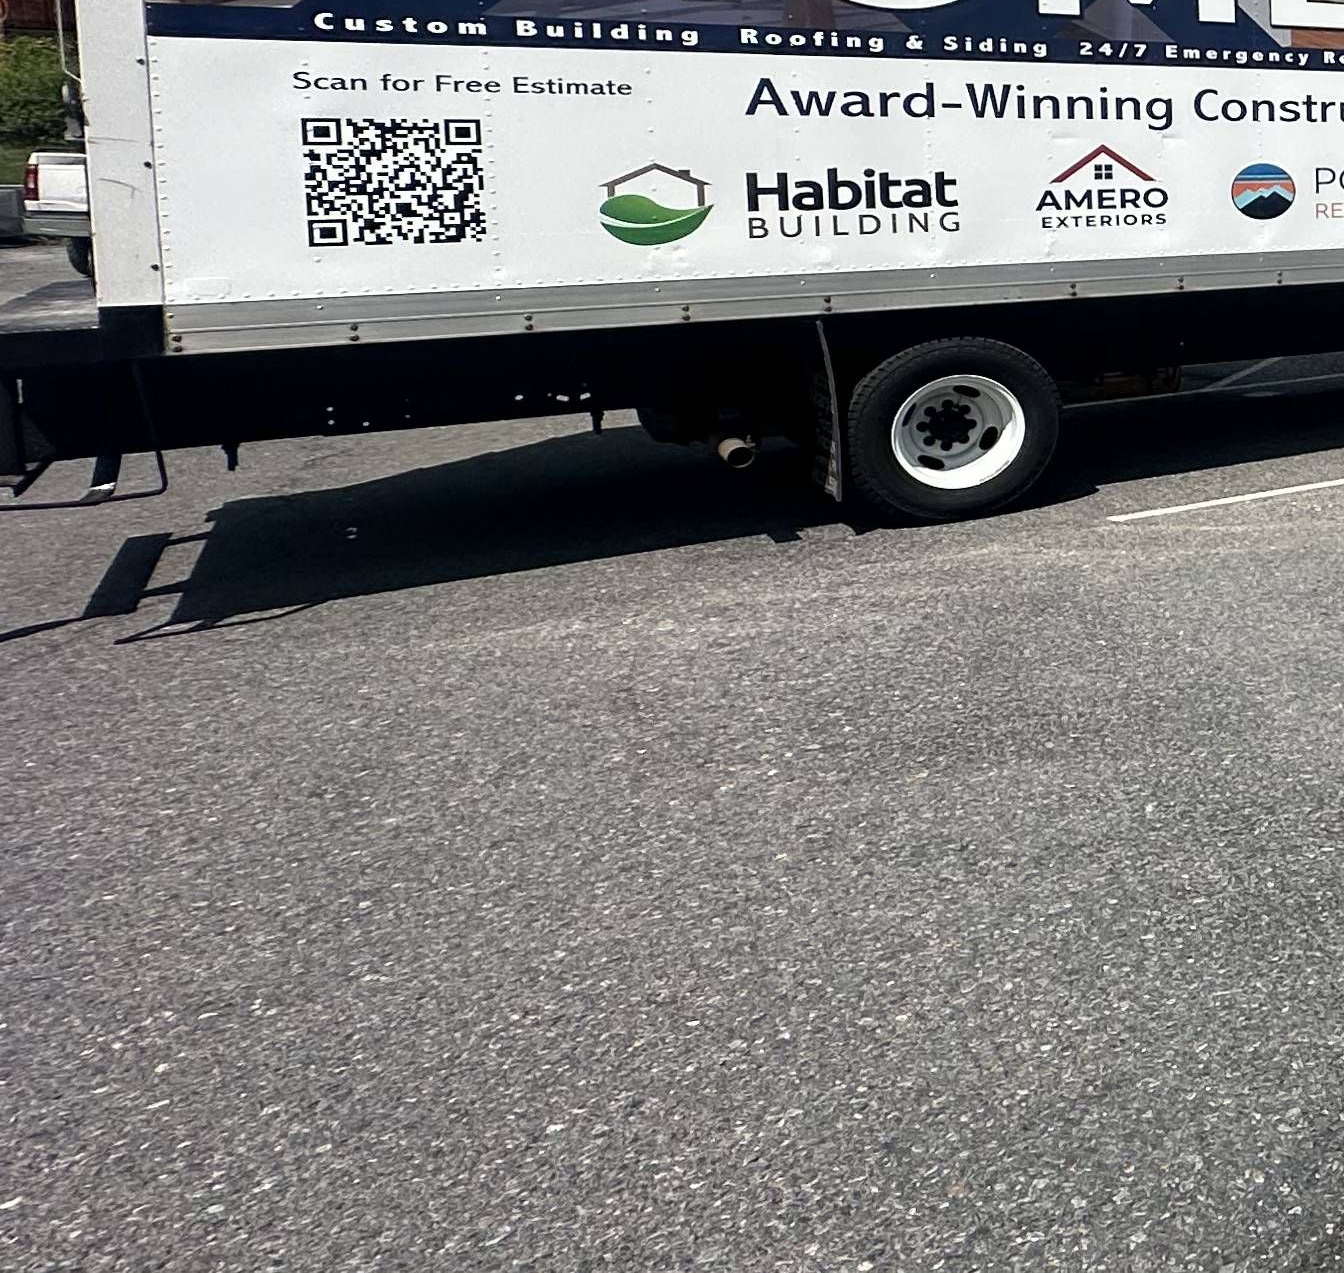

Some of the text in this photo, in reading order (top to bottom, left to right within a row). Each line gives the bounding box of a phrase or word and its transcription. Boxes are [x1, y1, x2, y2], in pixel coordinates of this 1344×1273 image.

[313, 11, 488, 37] Custom
[516, 19, 700, 47] Building
[740, 26, 886, 53] Roofing
[905, 36, 924, 52] &
[943, 35, 1049, 58] Siding
[1079, 42, 1149, 59] 24/7
[1165, 45, 1311, 68] Emergency
[293, 71, 634, 96] Scan for Free Estimate
[744, 77, 1175, 131] Award-Winning
[746, 167, 959, 213] Habitat
[1036, 188, 1168, 212] AMERO
[747, 212, 960, 241] BUILDING
[1041, 213, 1167, 230] EXTERIORS
